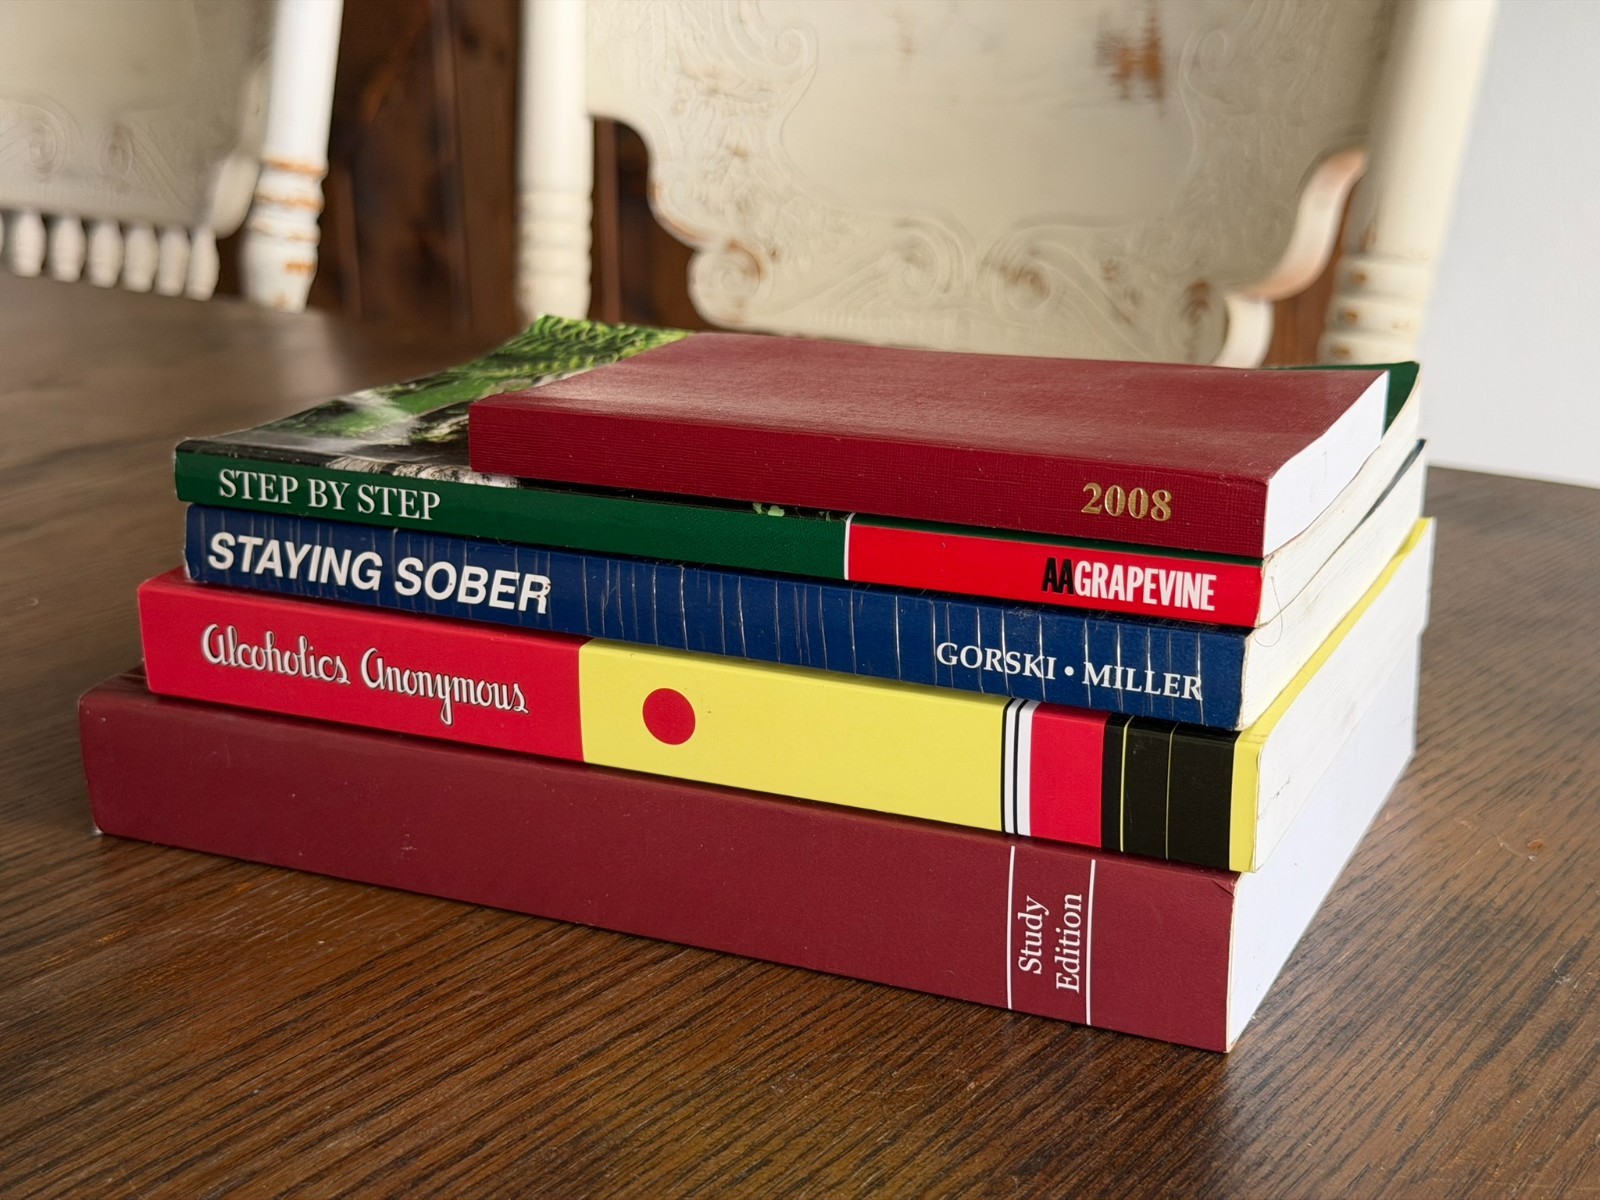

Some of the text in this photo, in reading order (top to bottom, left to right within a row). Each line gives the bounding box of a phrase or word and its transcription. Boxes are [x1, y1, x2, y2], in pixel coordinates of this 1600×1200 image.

[218, 468, 441, 520] STEP BY STEP
[1081, 482, 1173, 521] 2008
[207, 531, 551, 614] STAYING SOBER
[201, 623, 530, 726] Alcoholics Anonymous
[936, 641, 1204, 700] GORSKI MILLER
[1017, 895, 1050, 975] Study
[1054, 893, 1082, 993] Edition
